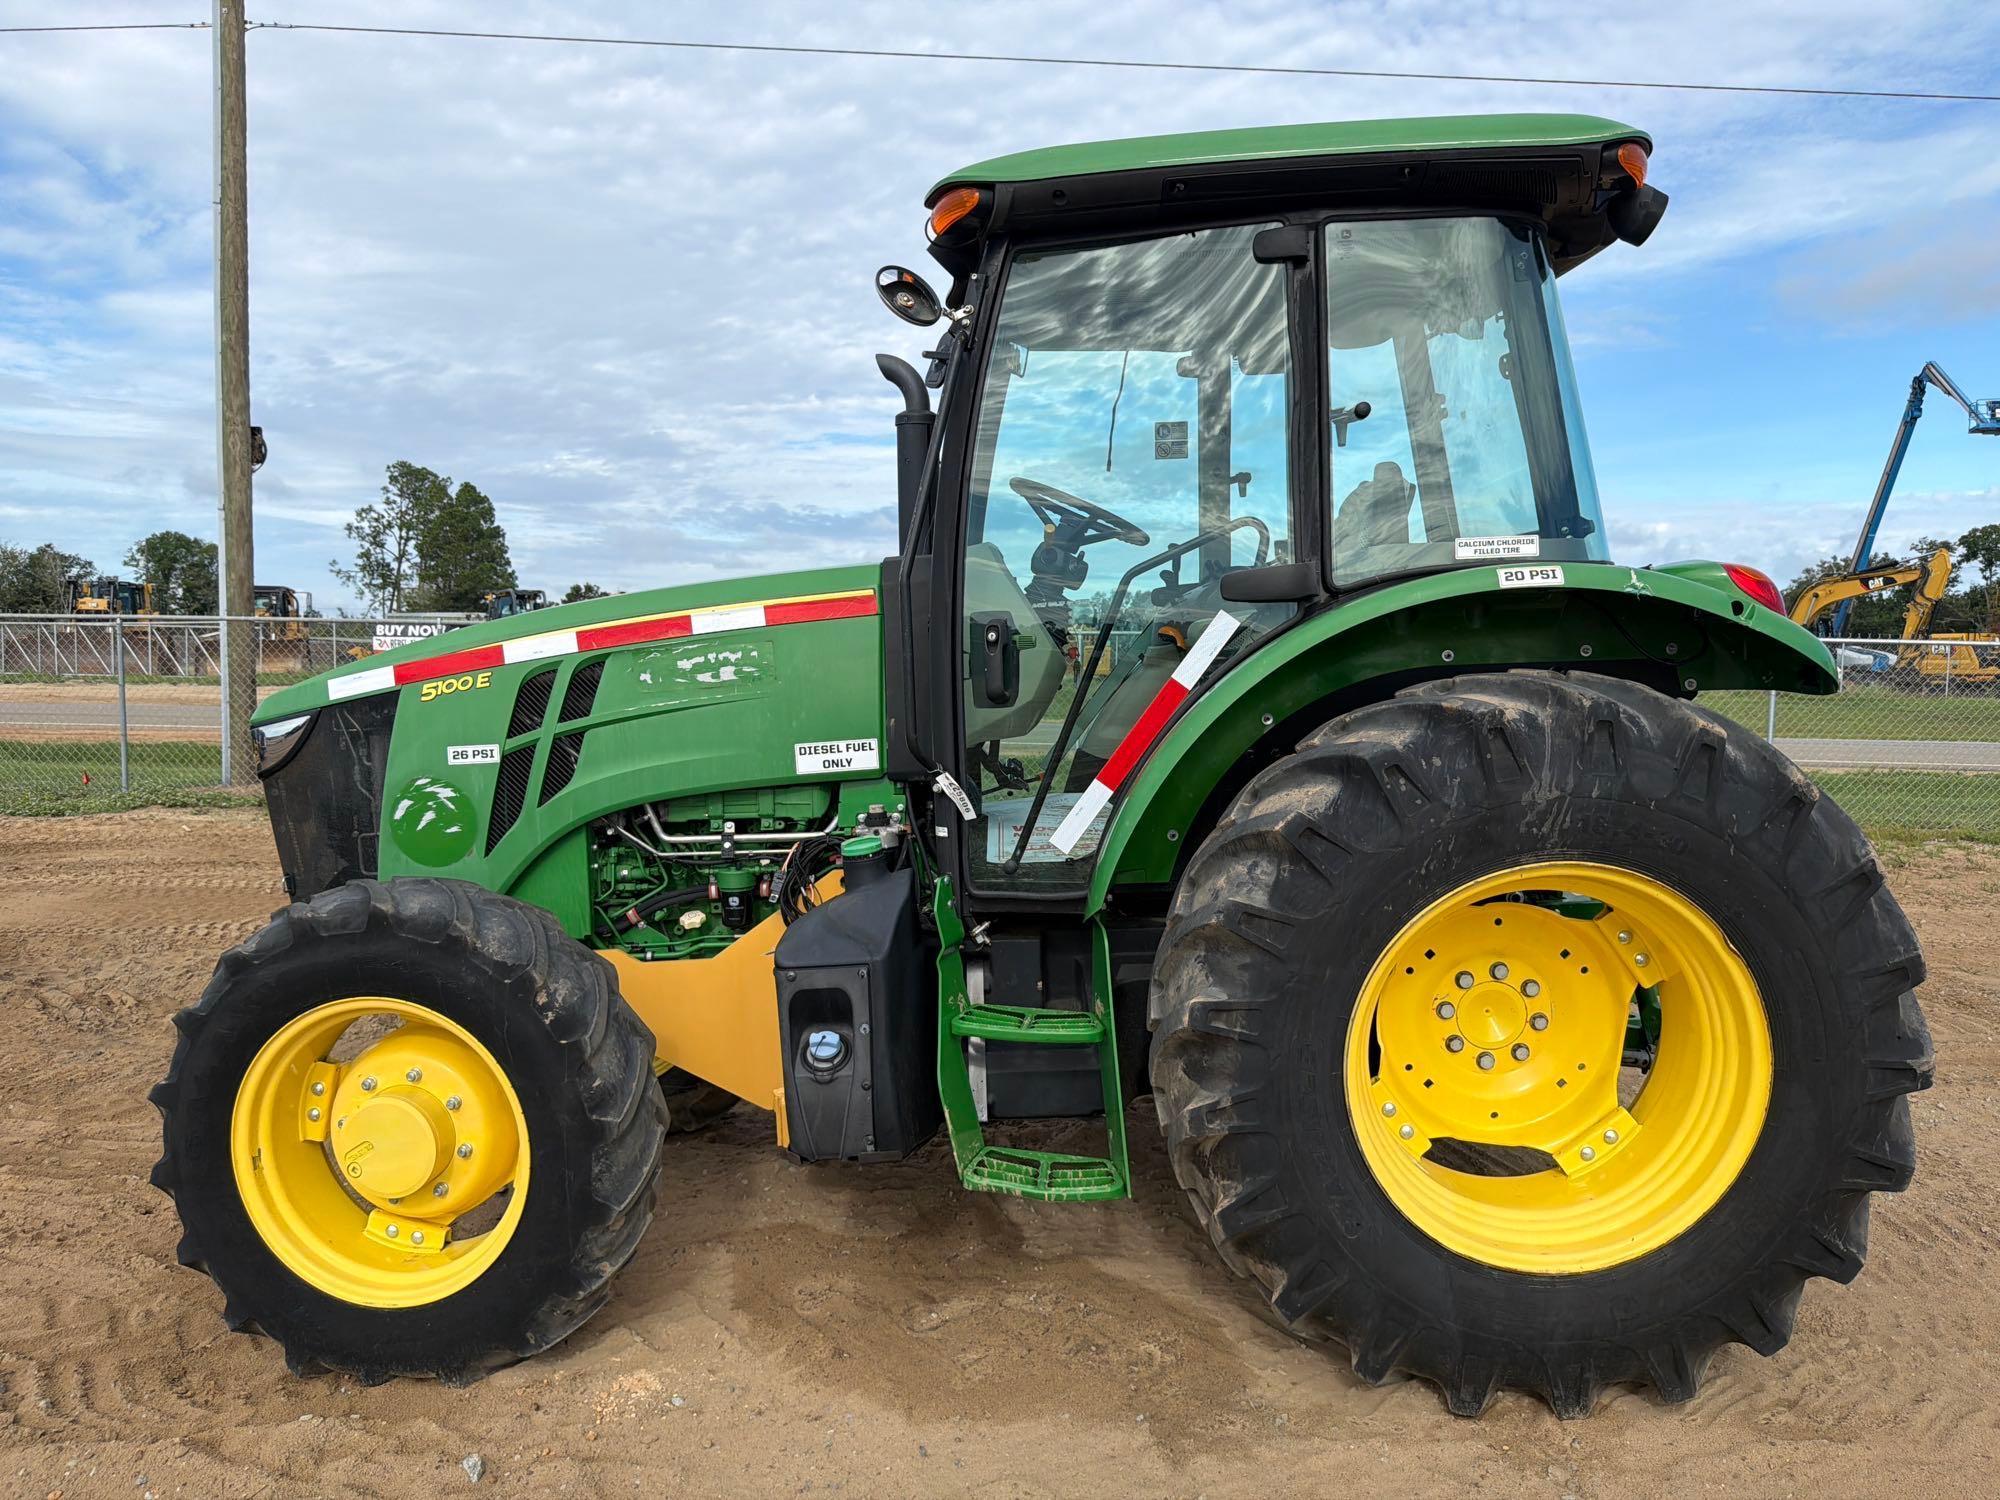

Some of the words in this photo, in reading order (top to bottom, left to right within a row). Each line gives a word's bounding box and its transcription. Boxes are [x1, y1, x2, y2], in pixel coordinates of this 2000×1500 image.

[1458, 540, 1495, 548] CALCIUM
[1496, 538, 1536, 546] CHLORIDE
[1473, 547, 1501, 555] FILLED
[1504, 570, 1526, 582] 20
[1529, 569, 1559, 580] PSI
[1868, 577, 1884, 589] CAT
[375, 624, 405, 636] BUY
[420, 676, 474, 702] 5100
[476, 671, 493, 690] E
[452, 750, 469, 761] 26
[472, 748, 495, 760] PSI
[798, 743, 843, 756] DIESEL
[845, 741, 875, 753] FUEL
[822, 758, 853, 769] ONLY
